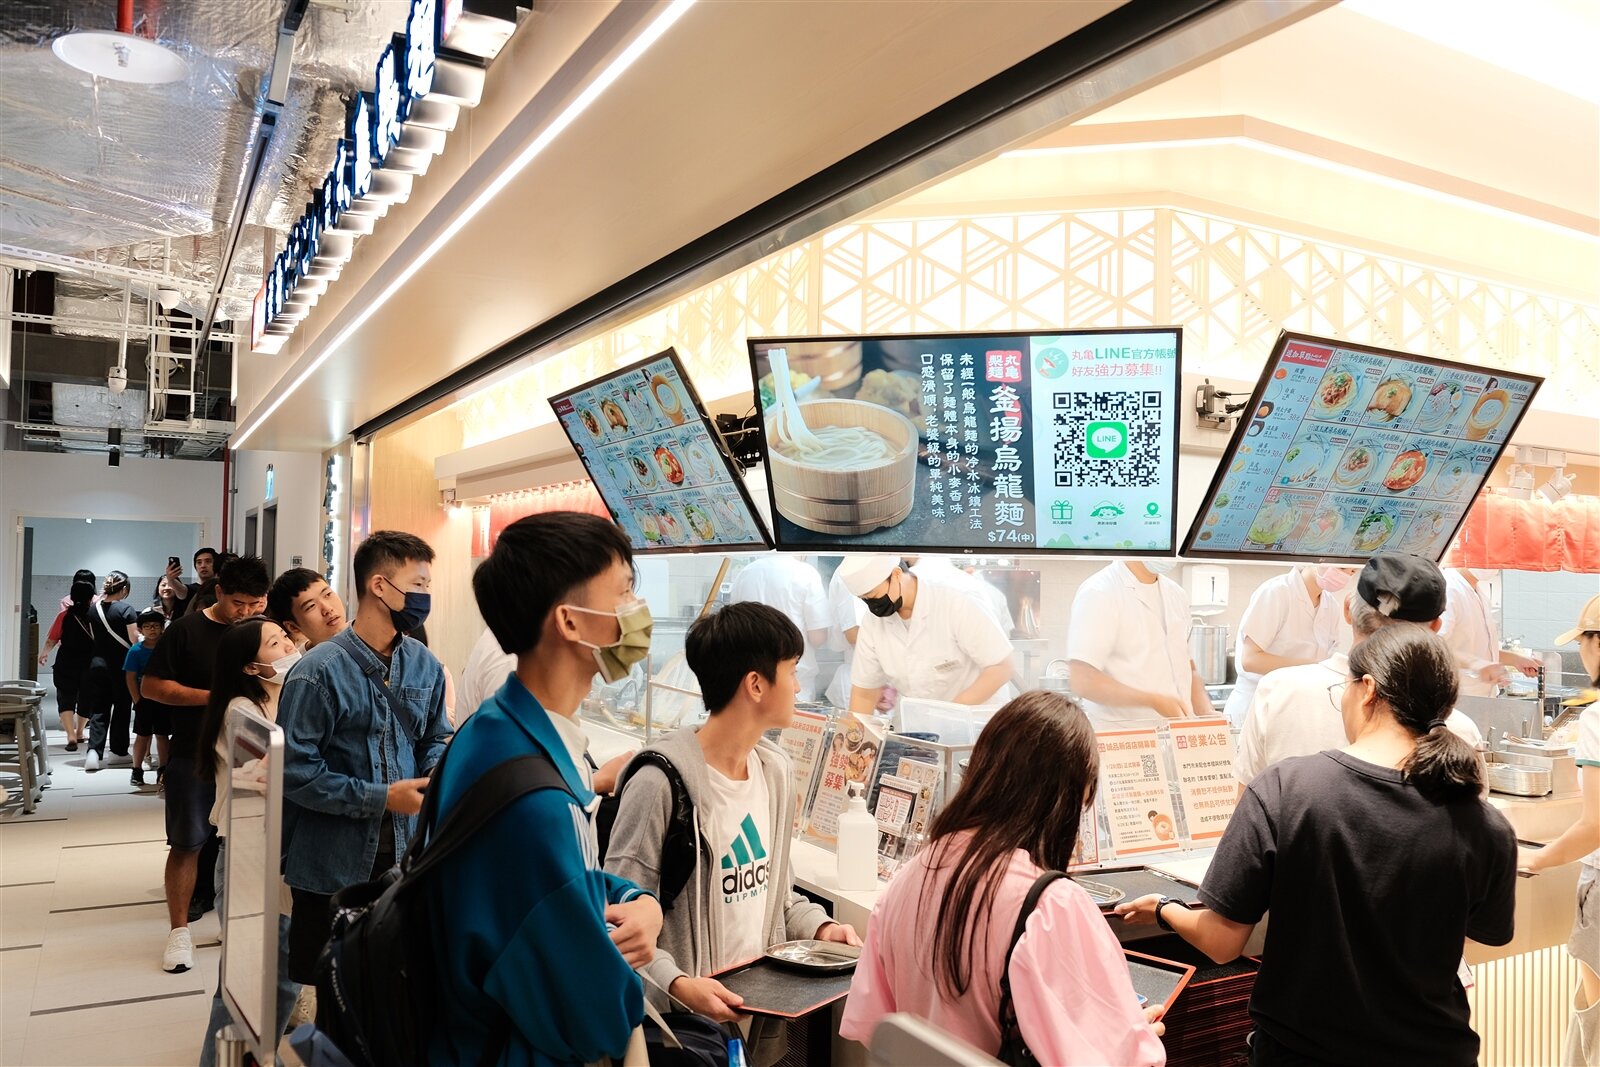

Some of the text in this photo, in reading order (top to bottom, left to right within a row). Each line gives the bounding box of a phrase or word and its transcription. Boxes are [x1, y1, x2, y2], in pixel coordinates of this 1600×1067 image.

[1072, 363, 1162, 377] 好友強力募集!!
[988, 384, 1025, 527] 釜揚烏龍麵
[988, 530, 1035, 543] $74(中)
[1187, 733, 1227, 748] 營業公告
[830, 751, 849, 770] 強勢
[824, 771, 843, 791] 募集
